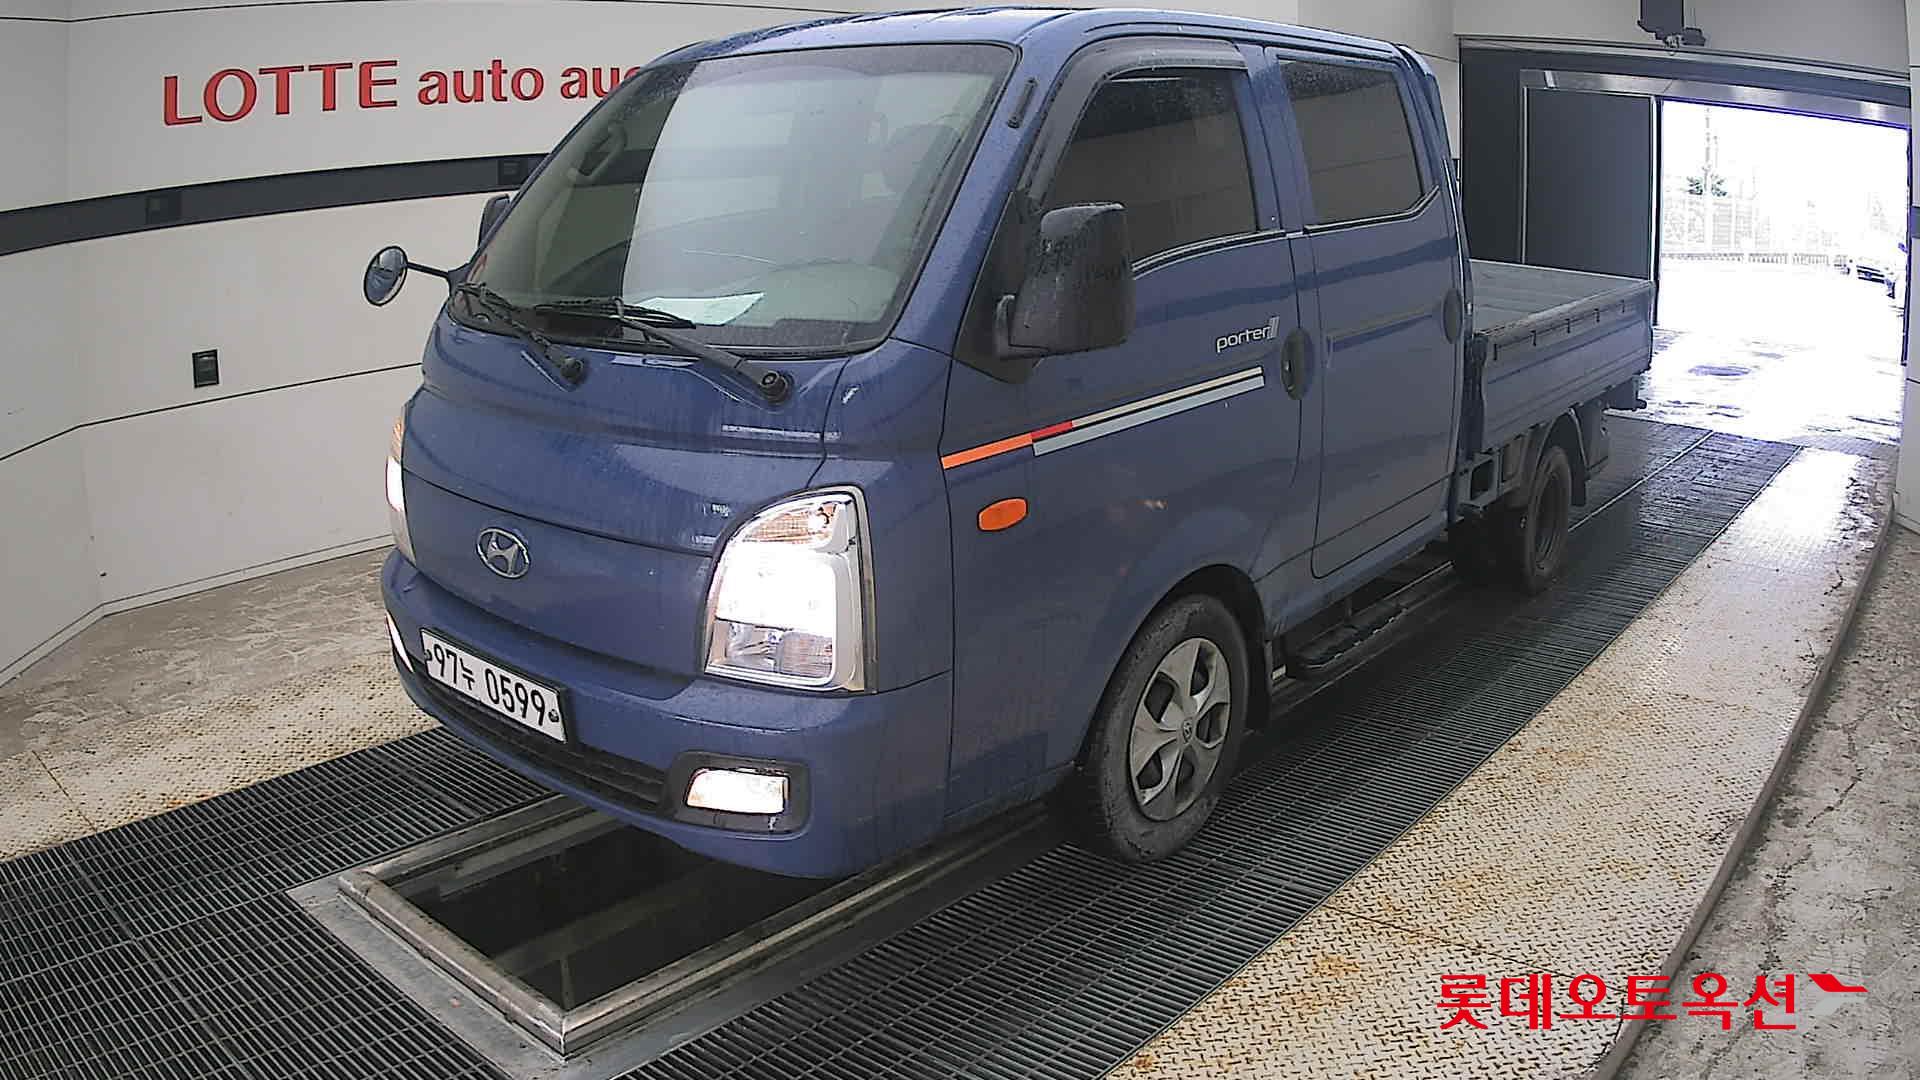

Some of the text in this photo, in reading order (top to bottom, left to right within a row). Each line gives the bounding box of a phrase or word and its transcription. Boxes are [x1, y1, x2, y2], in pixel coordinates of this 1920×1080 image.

[163, 60, 397, 126] LOTTE
[417, 59, 544, 105] auto
[485, 668, 546, 726] 0599
